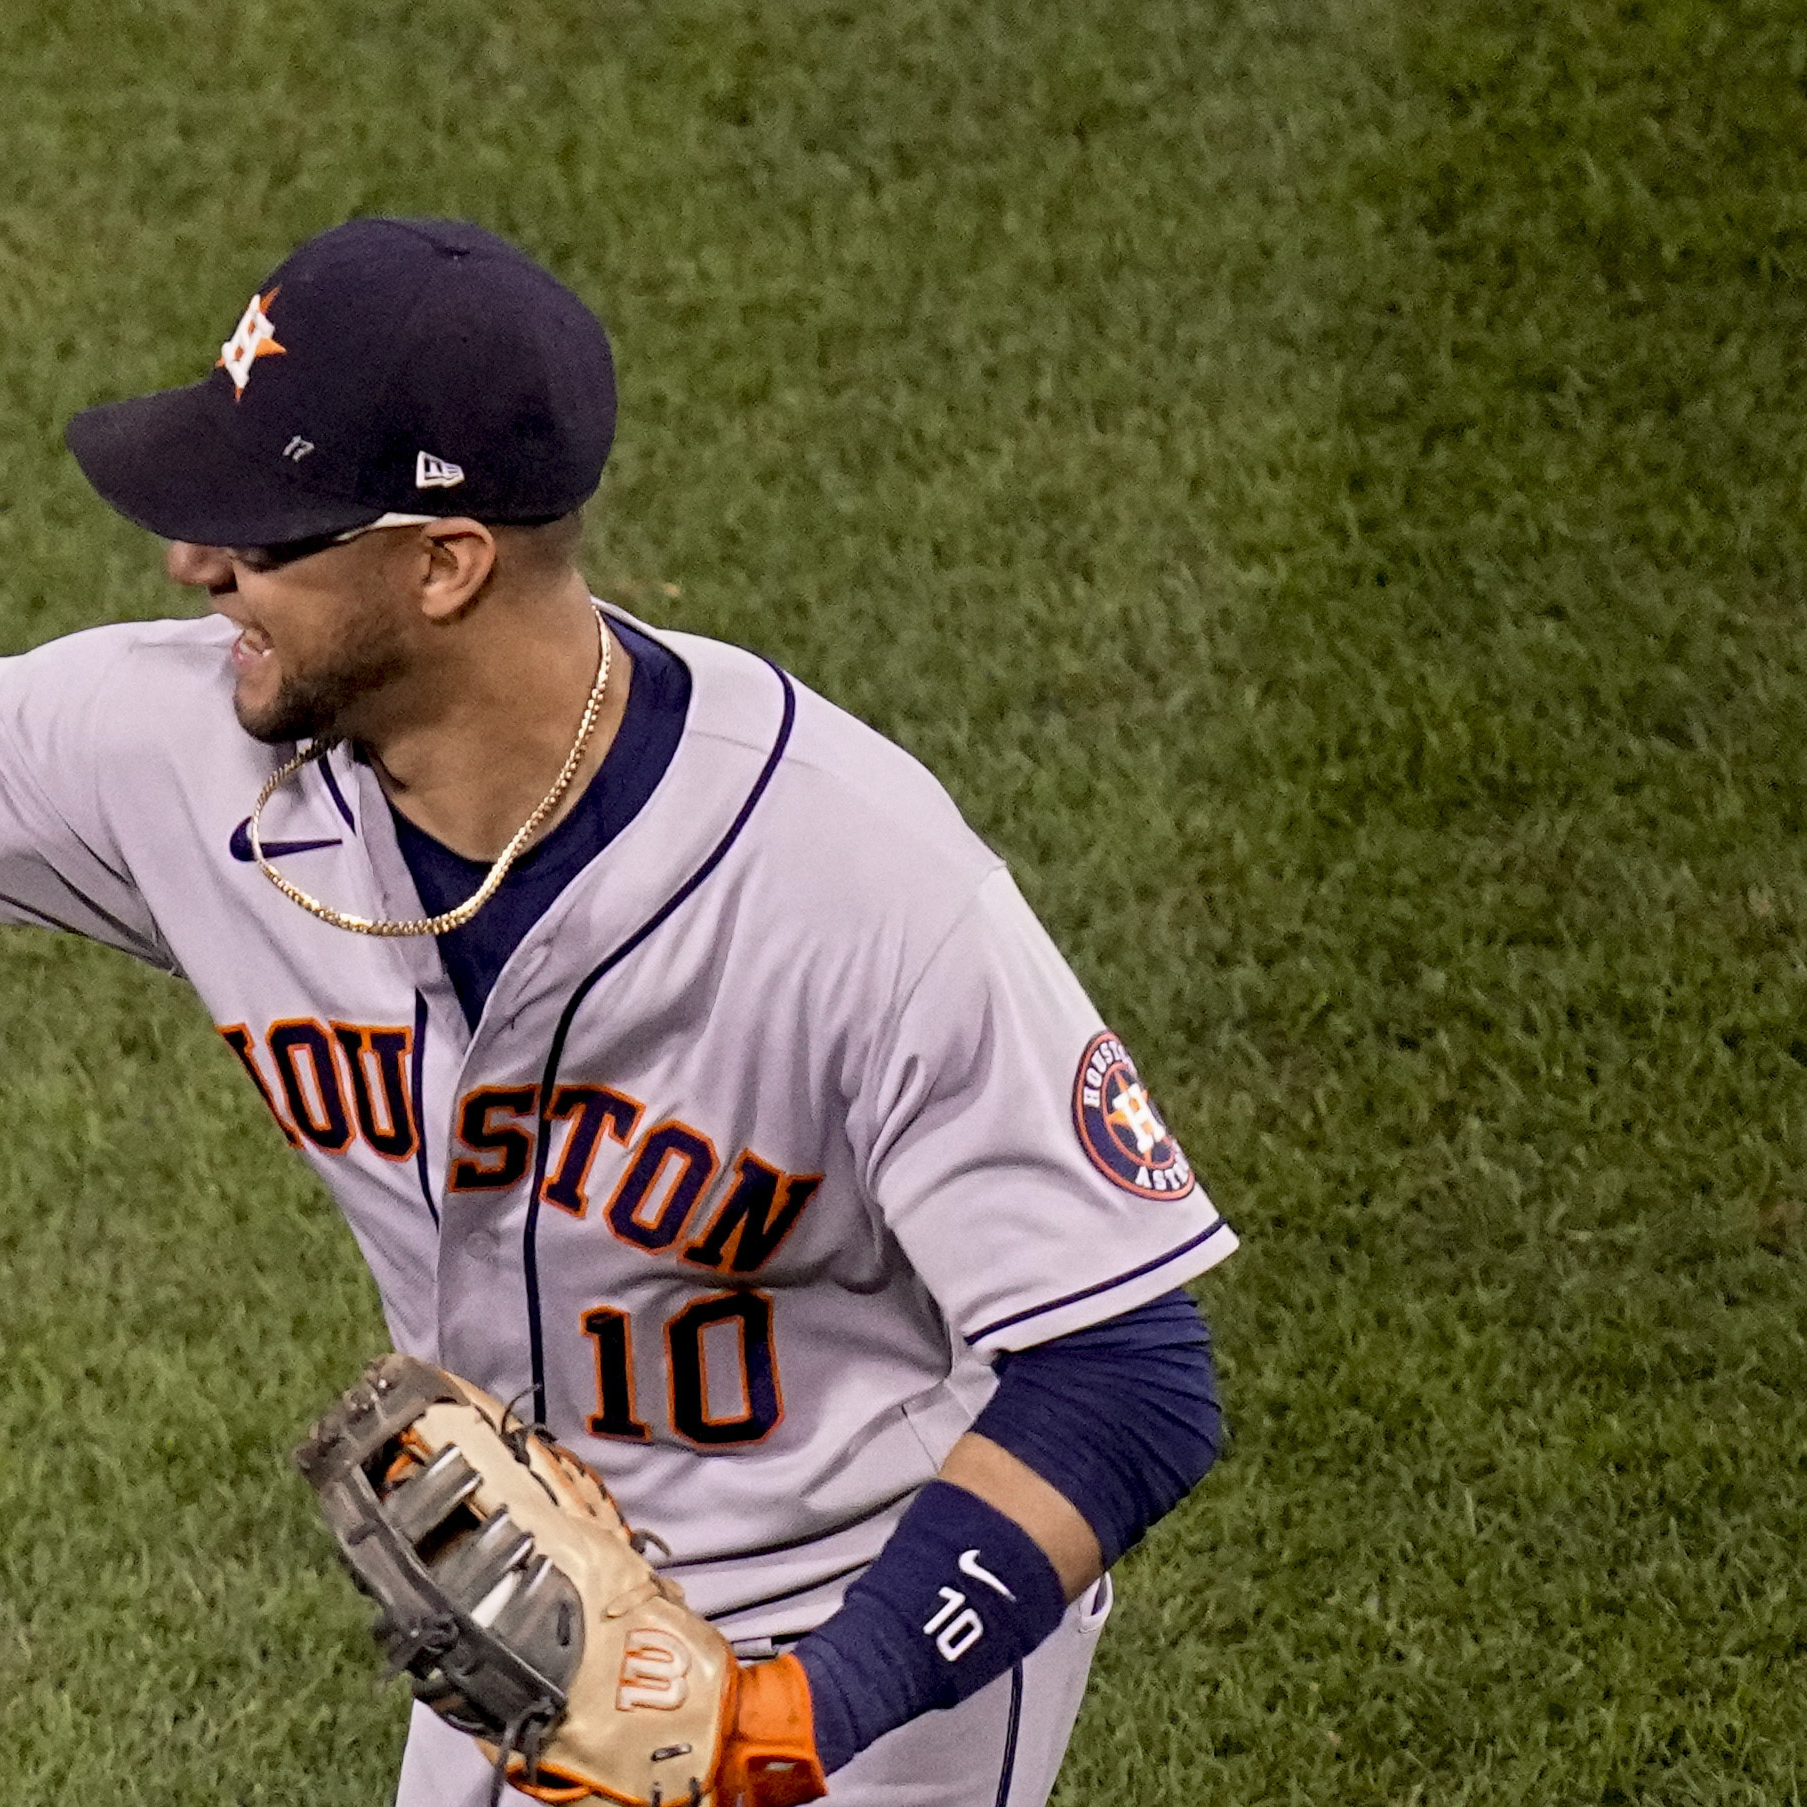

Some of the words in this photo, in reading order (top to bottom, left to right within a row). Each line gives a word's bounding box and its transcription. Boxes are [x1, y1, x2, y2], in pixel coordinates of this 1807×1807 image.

[1084, 1040, 1138, 1107] HOUST
[581, 1290, 785, 1450] 10
[922, 1586, 984, 1662] 10
